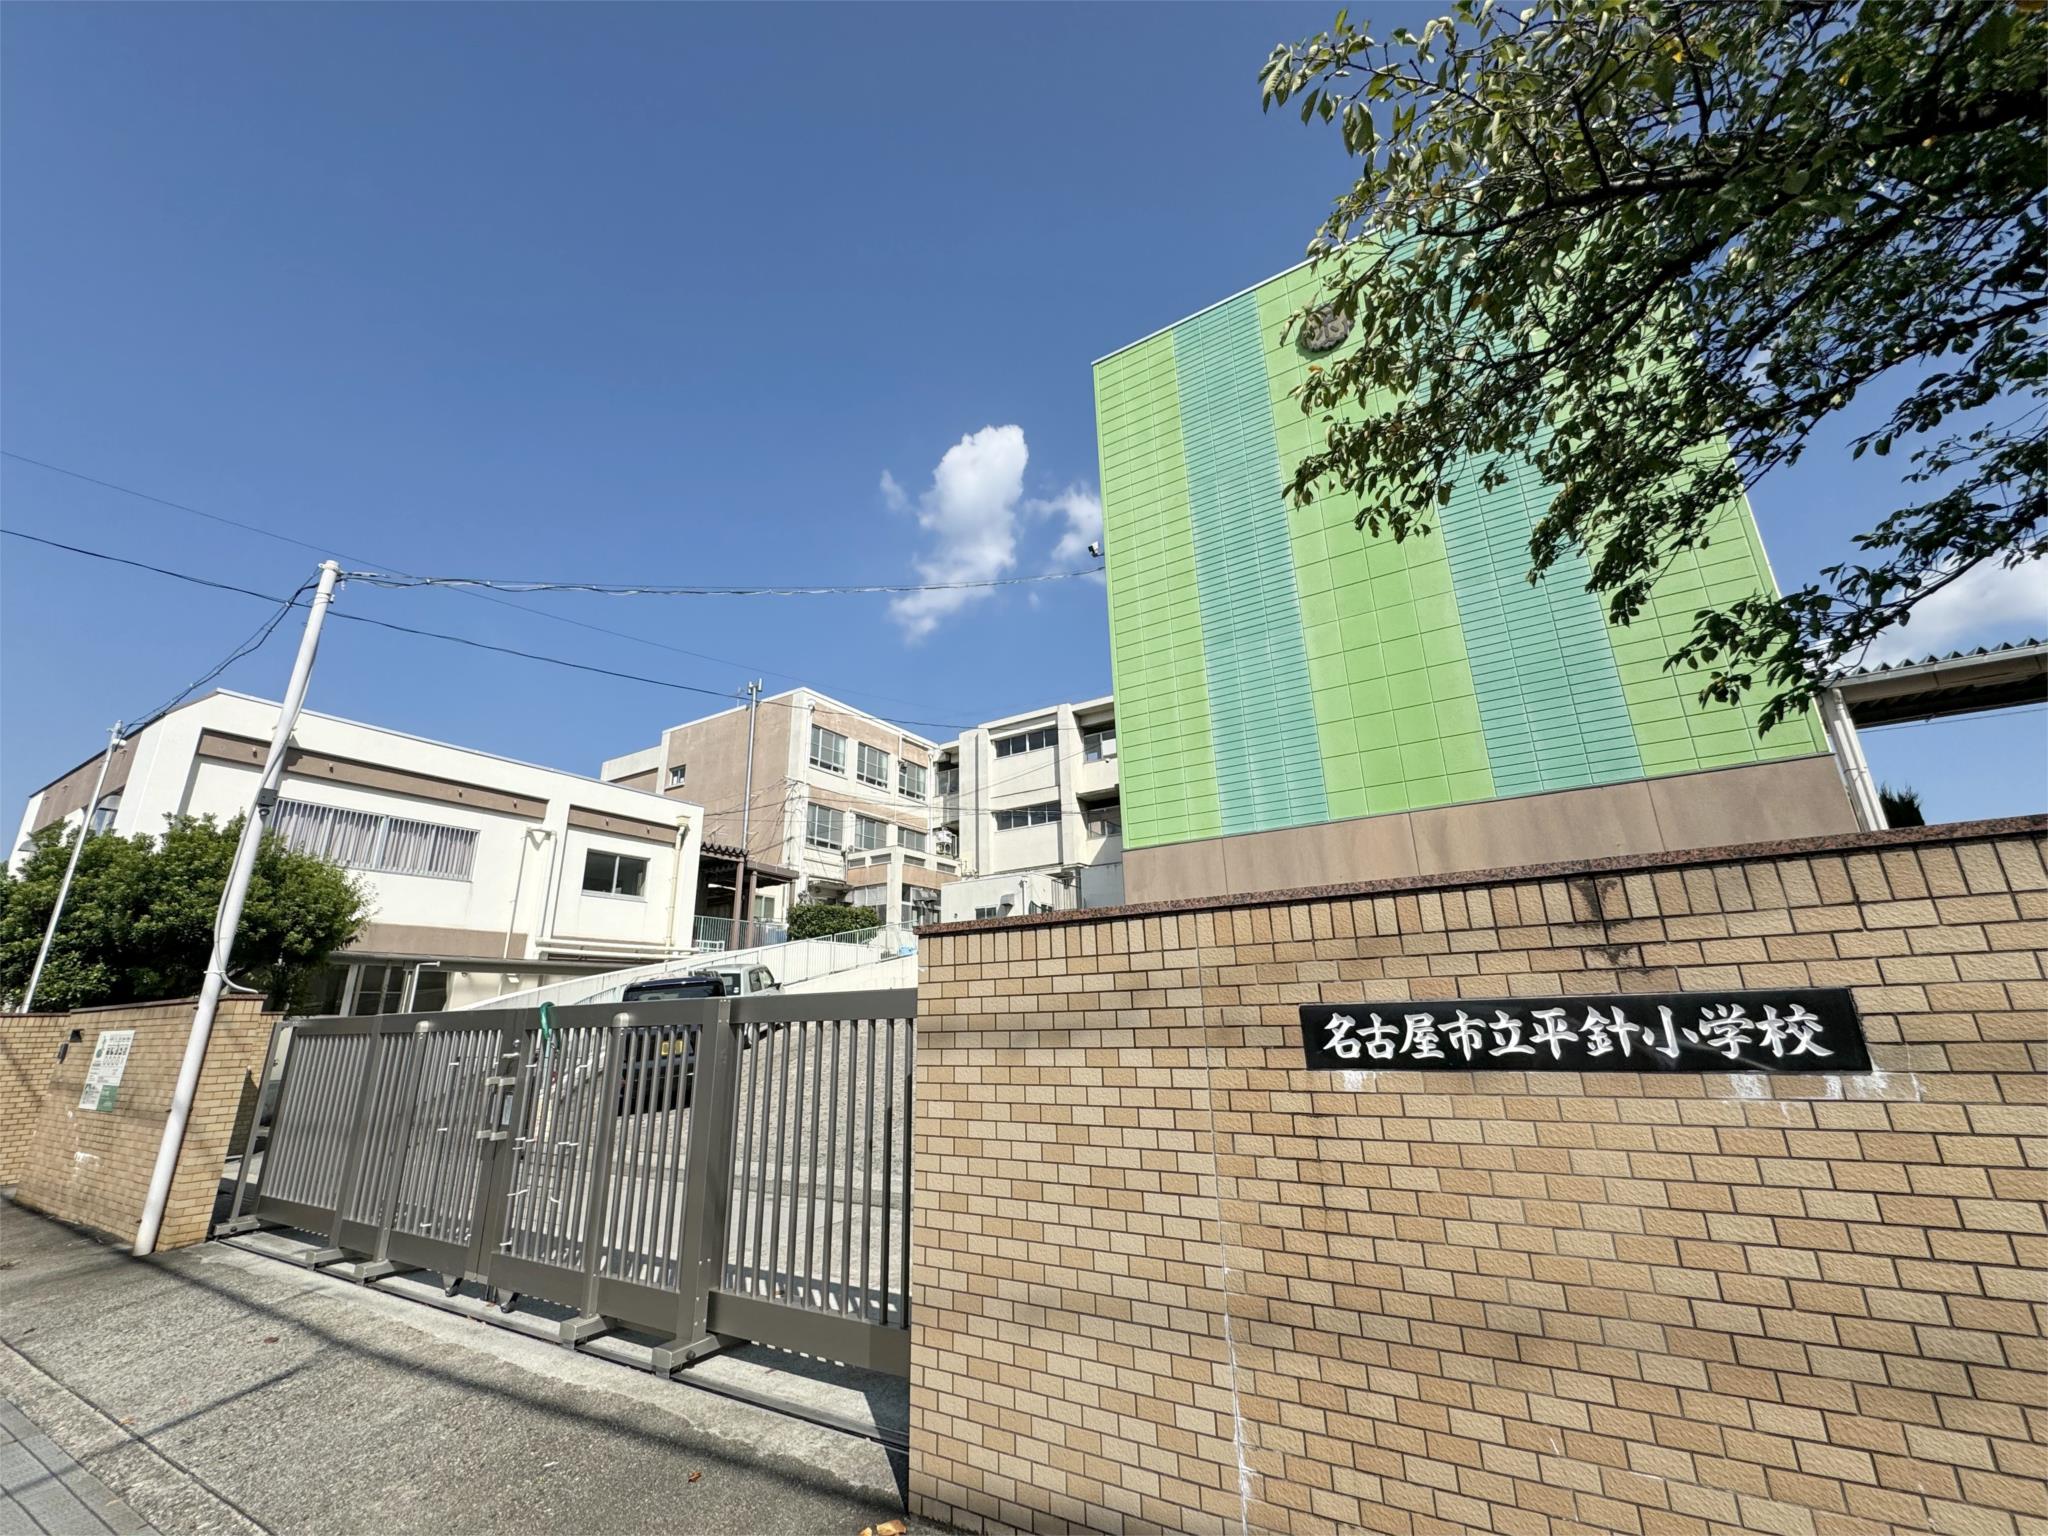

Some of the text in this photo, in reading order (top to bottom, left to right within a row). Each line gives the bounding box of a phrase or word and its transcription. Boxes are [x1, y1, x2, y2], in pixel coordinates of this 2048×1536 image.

[1323, 1003, 1834, 1060] 名古屋市立平針小学校
